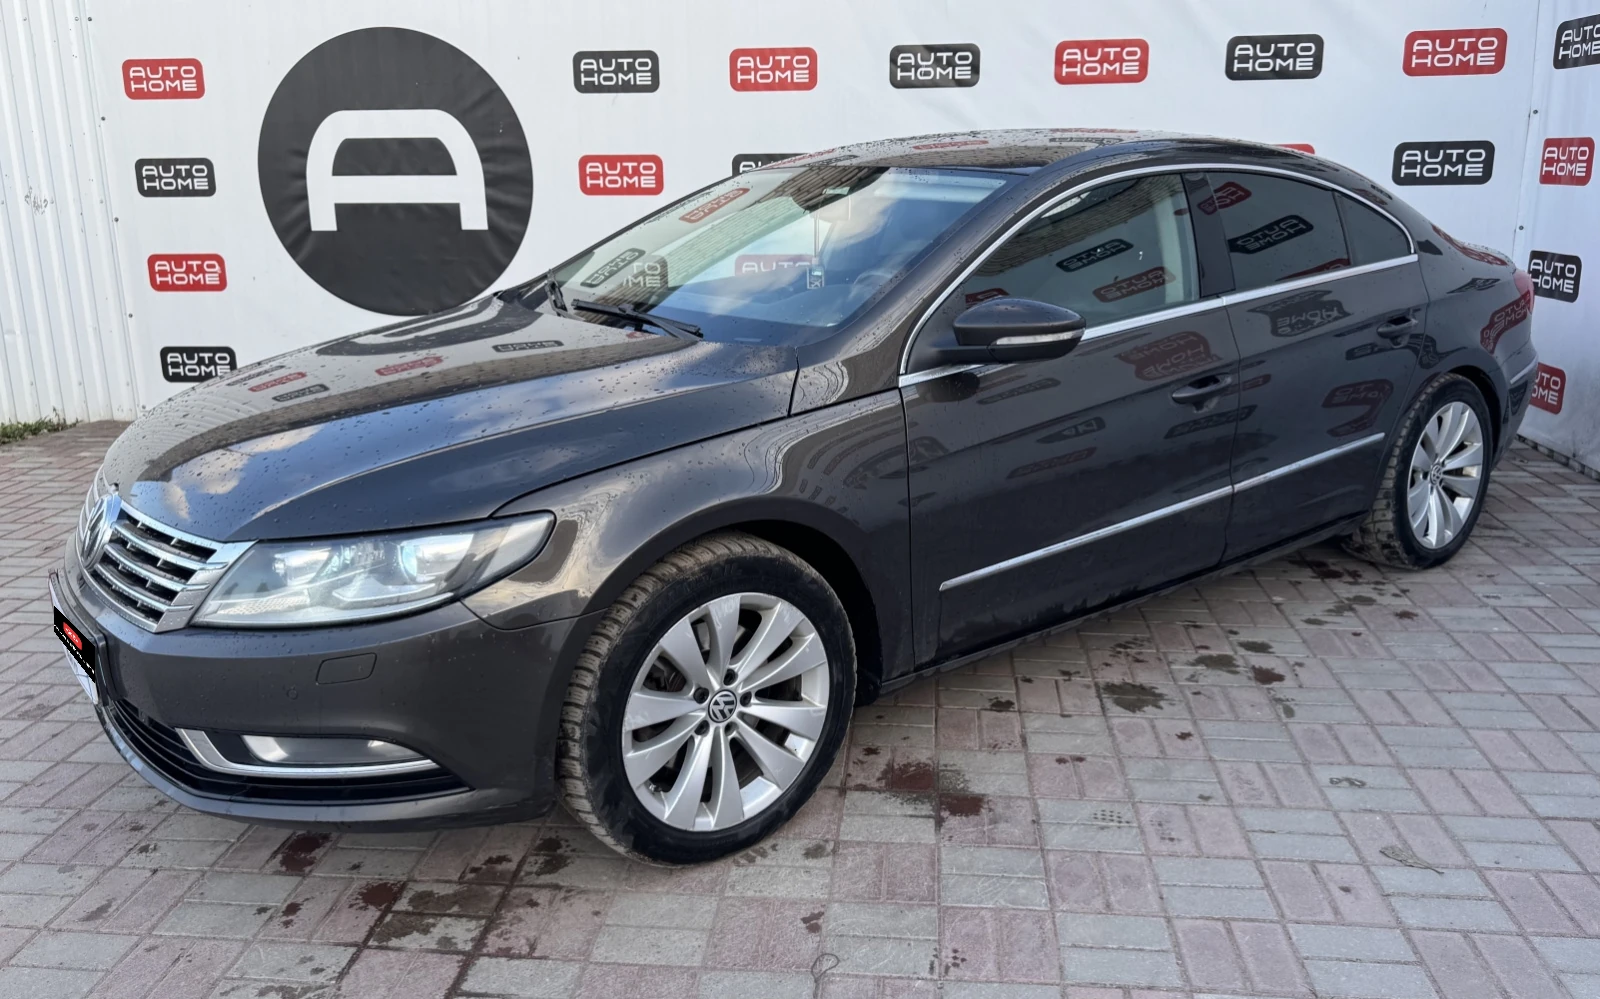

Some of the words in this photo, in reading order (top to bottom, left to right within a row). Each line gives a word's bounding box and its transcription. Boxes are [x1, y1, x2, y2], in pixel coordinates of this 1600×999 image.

[1234, 42, 1316, 57] AUTO
[1413, 36, 1499, 52] AUTO
[1558, 41, 1600, 60] HOME
[897, 51, 973, 66] AUTO
[1063, 47, 1142, 62] AUTO
[1411, 52, 1496, 68] HOME
[580, 58, 652, 72] AUTO
[736, 55, 811, 70] AUTO
[1062, 61, 1140, 76] HOME
[1233, 57, 1314, 72] HOME
[129, 66, 197, 79] AUTO
[580, 72, 652, 86] HOME
[737, 69, 810, 84] HOME
[897, 66, 972, 81] HOME
[131, 79, 198, 92] HOME
[1401, 149, 1486, 163] AUTO
[1544, 146, 1589, 160] AUTO
[142, 164, 208, 177] AUTO
[585, 162, 656, 175] AUTO
[1400, 163, 1484, 178] HOME
[1542, 162, 1587, 177] HOME
[143, 178, 209, 190] HOME
[586, 175, 656, 188] HOME
[154, 260, 220, 273] AUTO
[1530, 259, 1577, 278] AUTO
[156, 273, 220, 285] HOME
[1530, 273, 1574, 294] HOME
[167, 352, 230, 364] AUTO
[168, 365, 231, 376] HOME
[1531, 385, 1559, 405] OME
